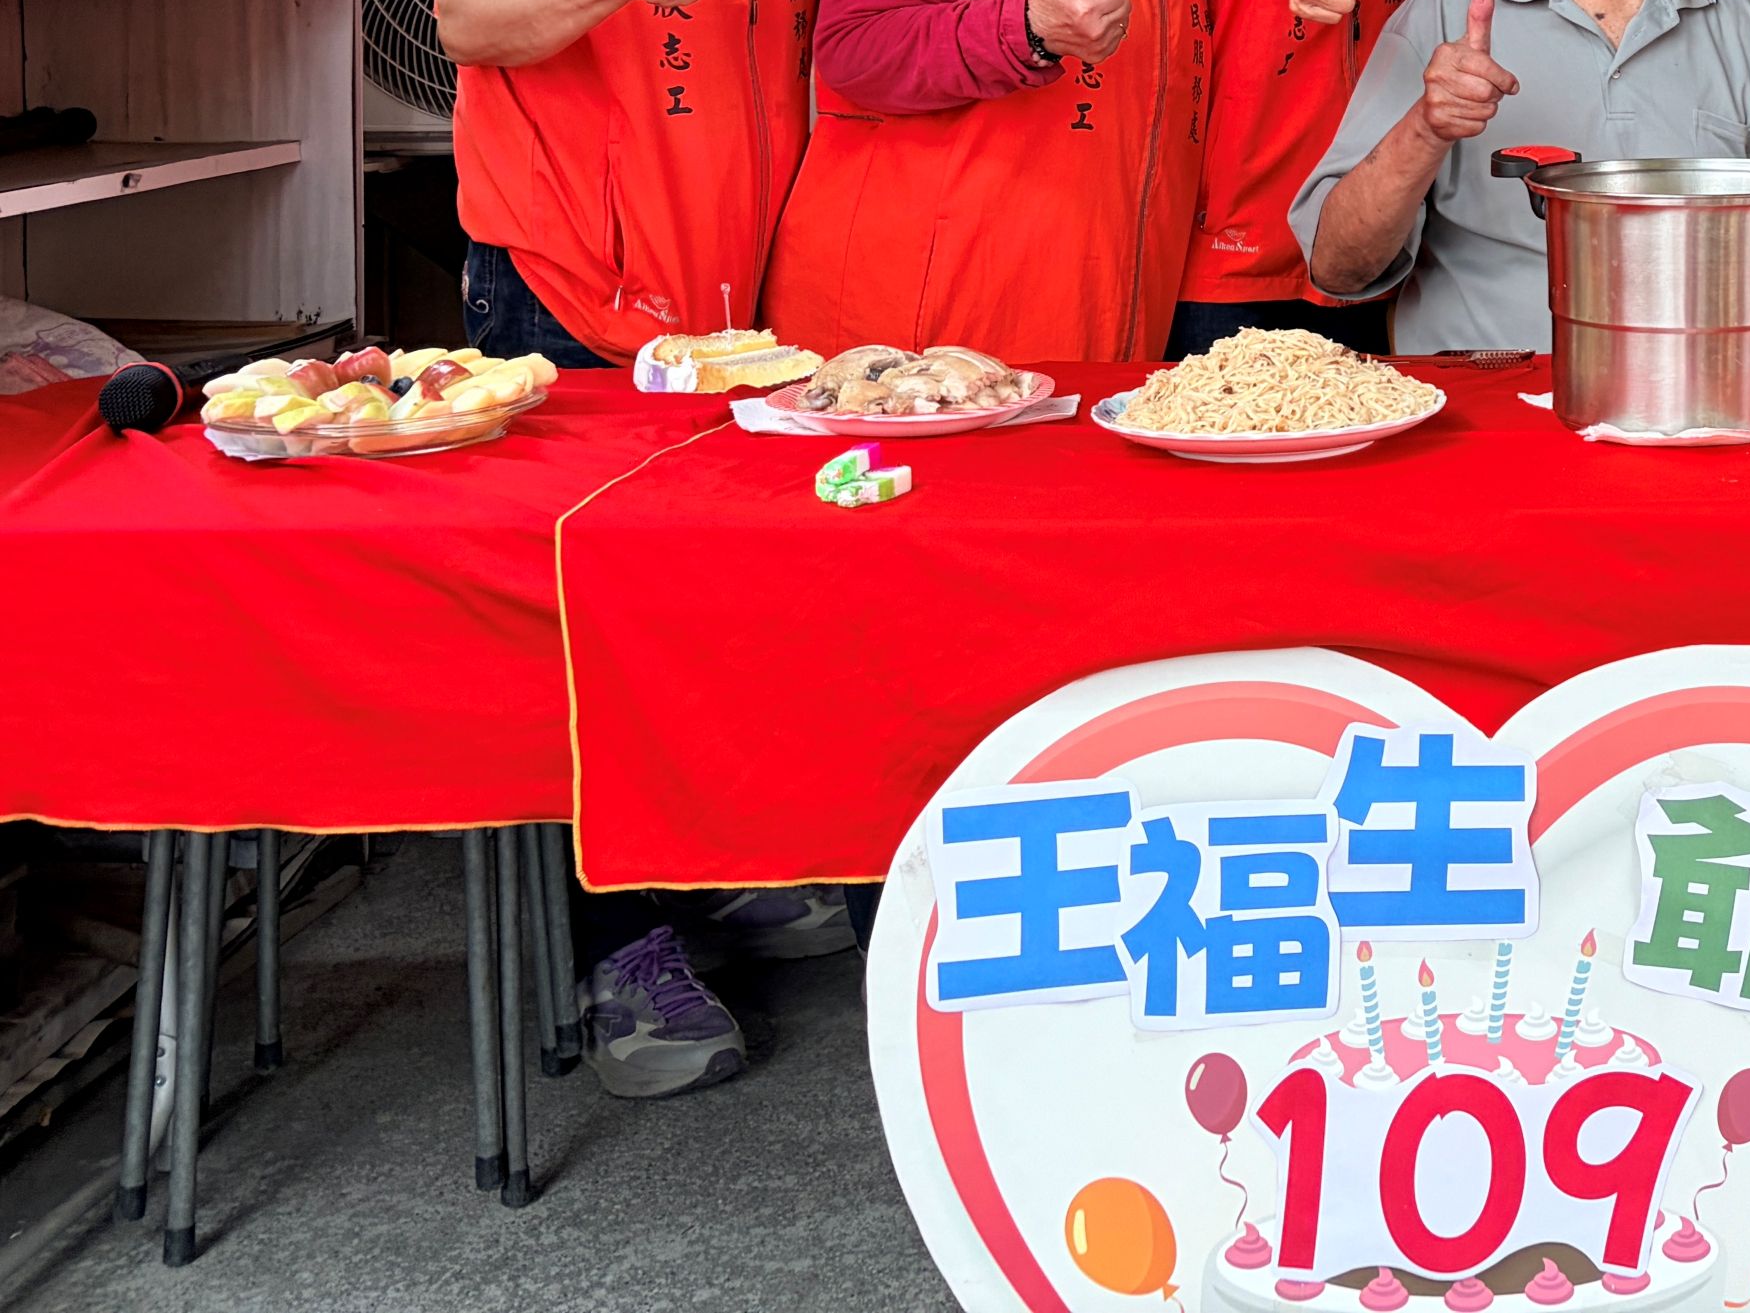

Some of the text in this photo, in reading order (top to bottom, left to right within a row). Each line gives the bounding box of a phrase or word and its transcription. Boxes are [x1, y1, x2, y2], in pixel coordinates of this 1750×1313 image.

[938, 732, 1527, 1018] 王福生
[1254, 1066, 1697, 1274] 109
